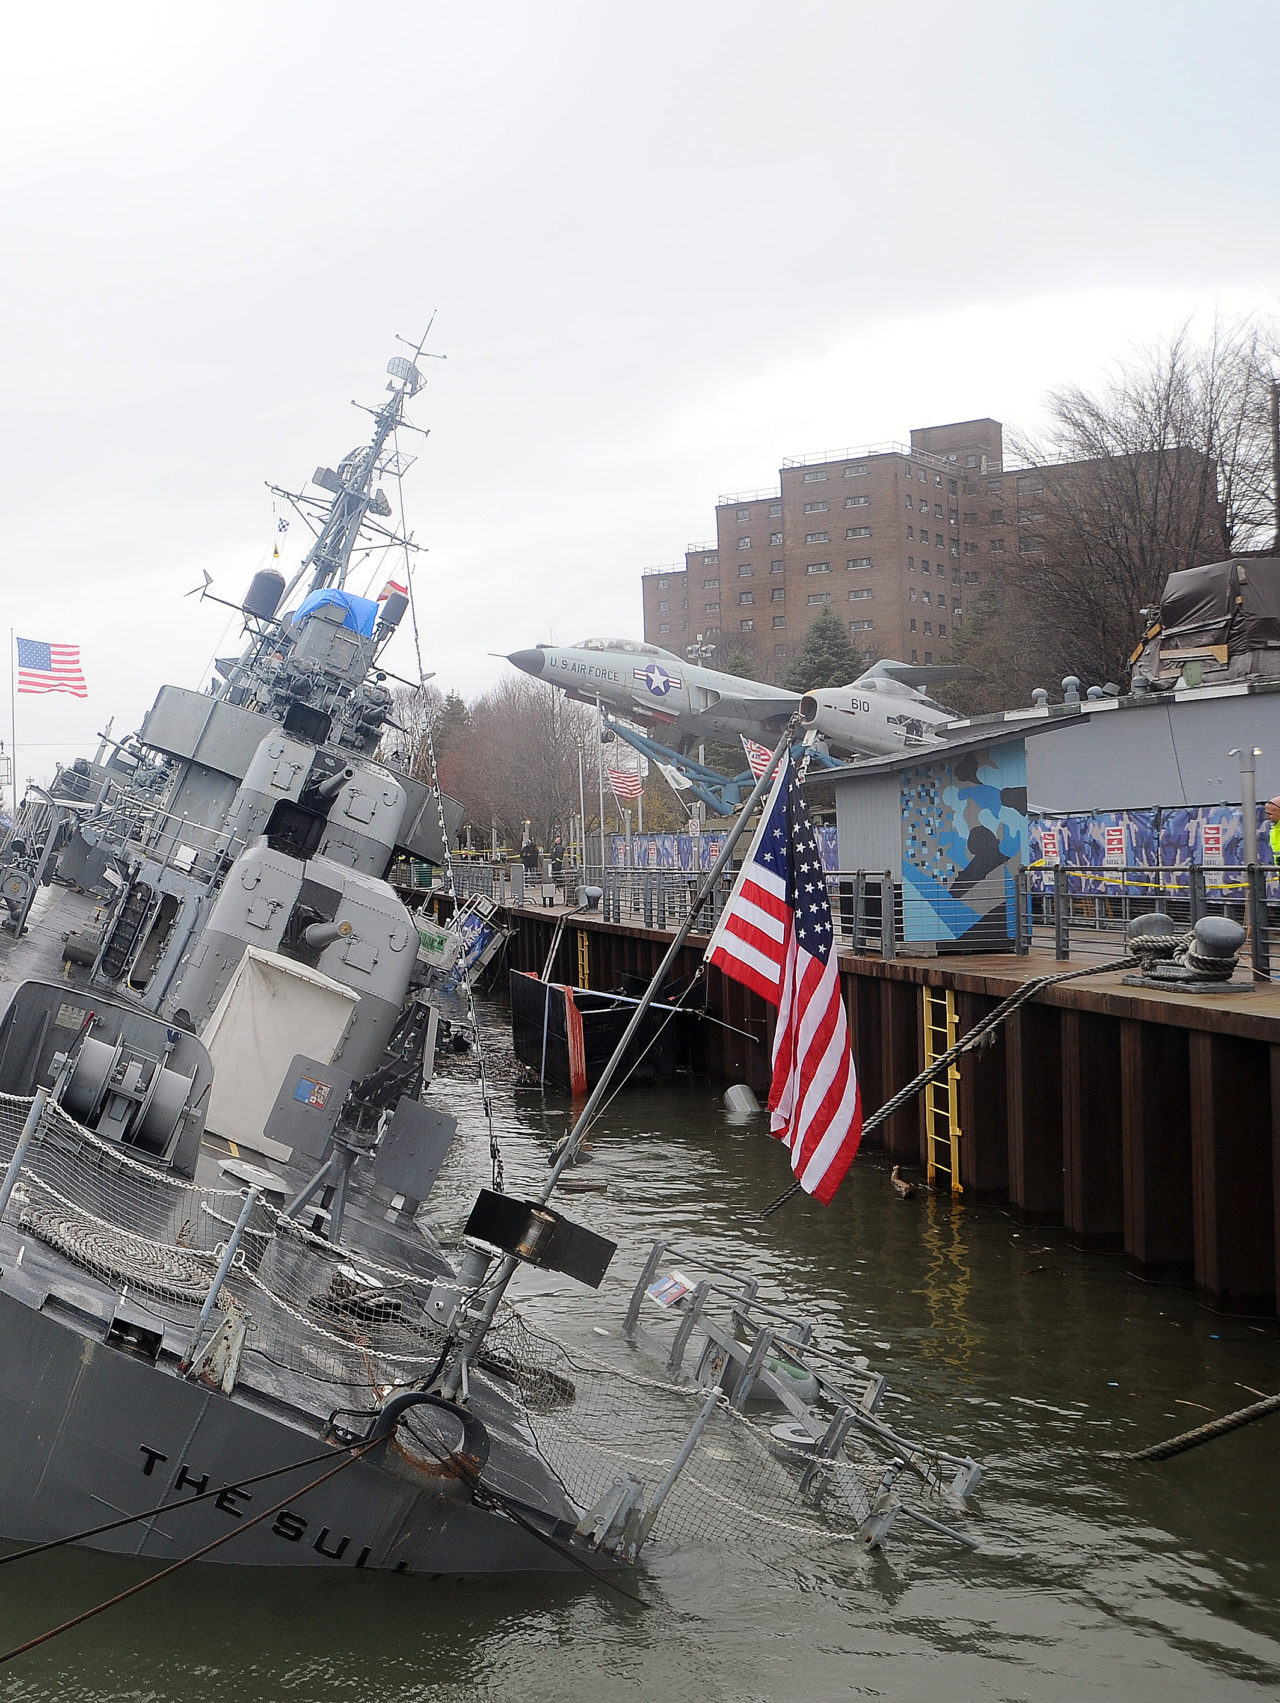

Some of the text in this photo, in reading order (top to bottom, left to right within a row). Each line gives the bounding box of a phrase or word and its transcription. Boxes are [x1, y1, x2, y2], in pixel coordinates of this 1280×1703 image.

[571, 661, 587, 675] AIR
[589, 666, 620, 682] FORCE
[852, 698, 869, 713] 610
[139, 1443, 253, 1518] THE
